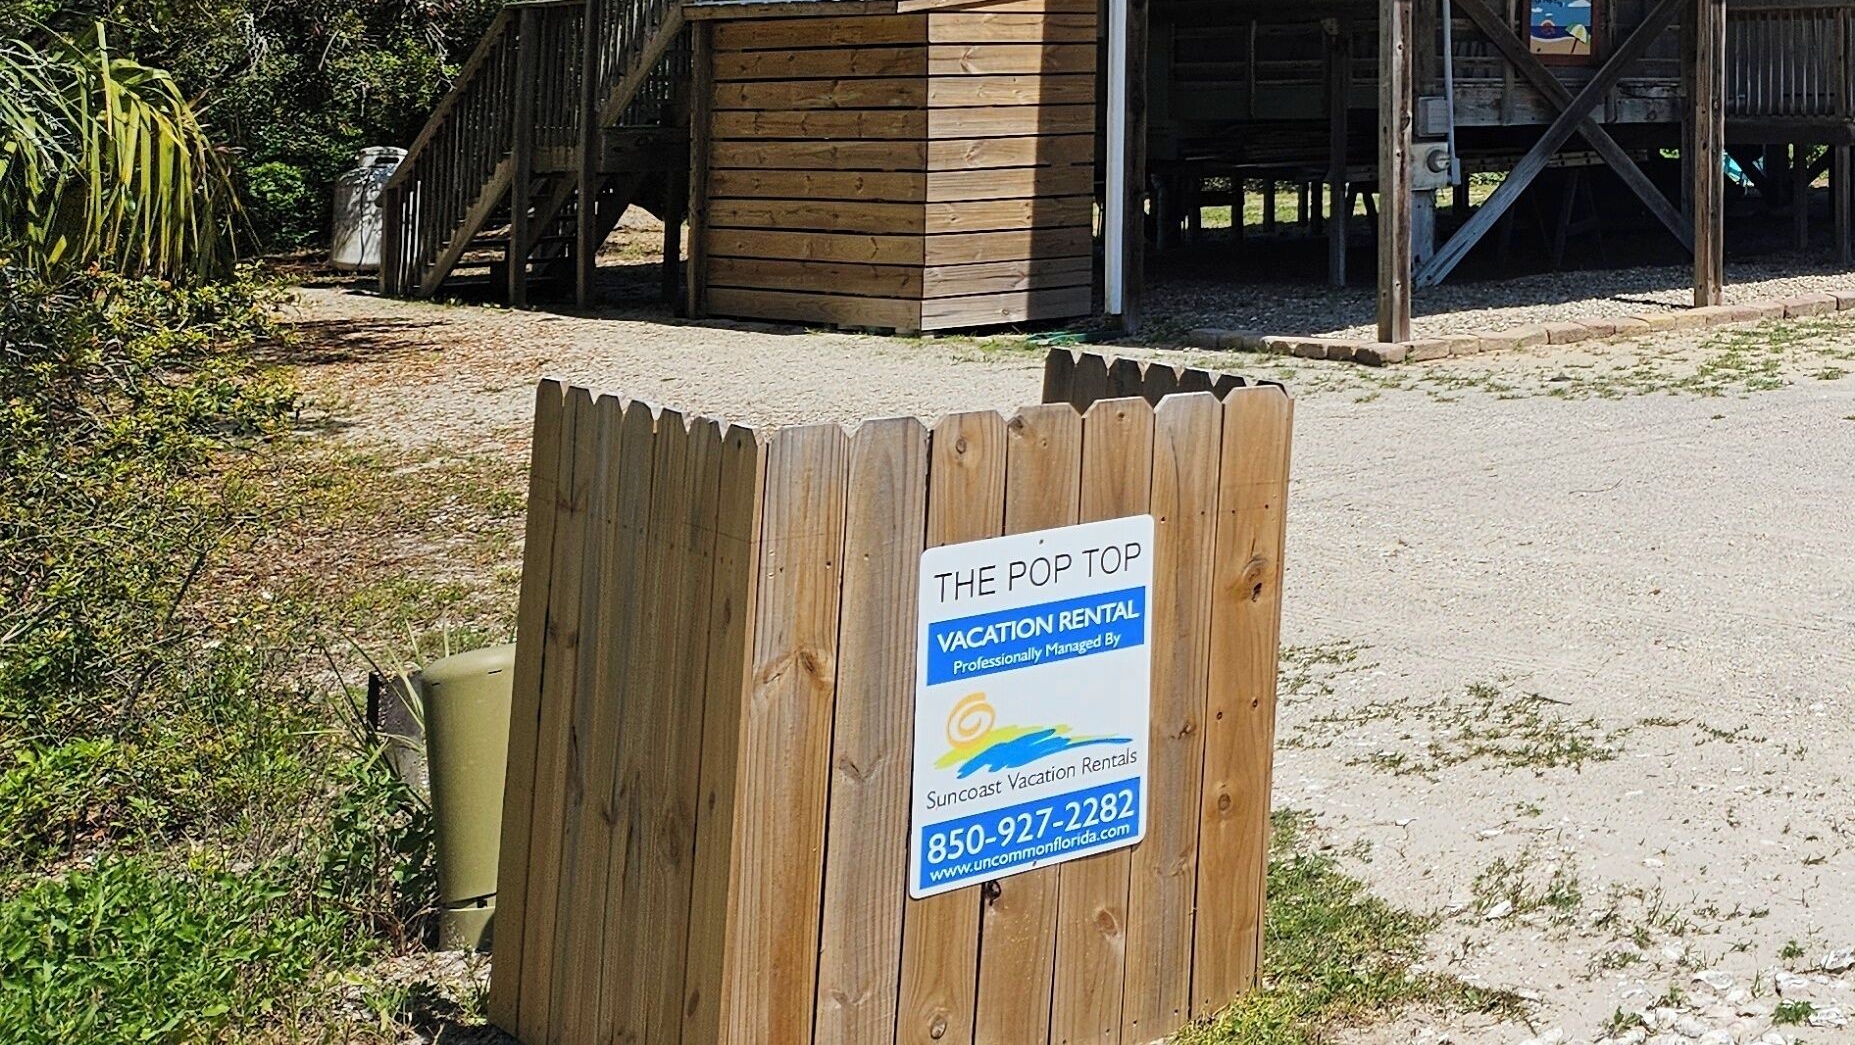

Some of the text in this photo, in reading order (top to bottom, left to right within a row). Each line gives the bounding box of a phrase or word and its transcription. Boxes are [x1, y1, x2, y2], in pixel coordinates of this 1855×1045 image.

[934, 542, 1141, 604] THE POP TOP
[937, 598, 1140, 653] VACATION RENTAL
[953, 631, 1122, 675] Professionally Managed By
[926, 748, 1137, 811] Suncoast Vacation Rentals
[927, 788, 1134, 865] 850-927-2282
[929, 823, 1130, 882] www.uncommonflorida.com
